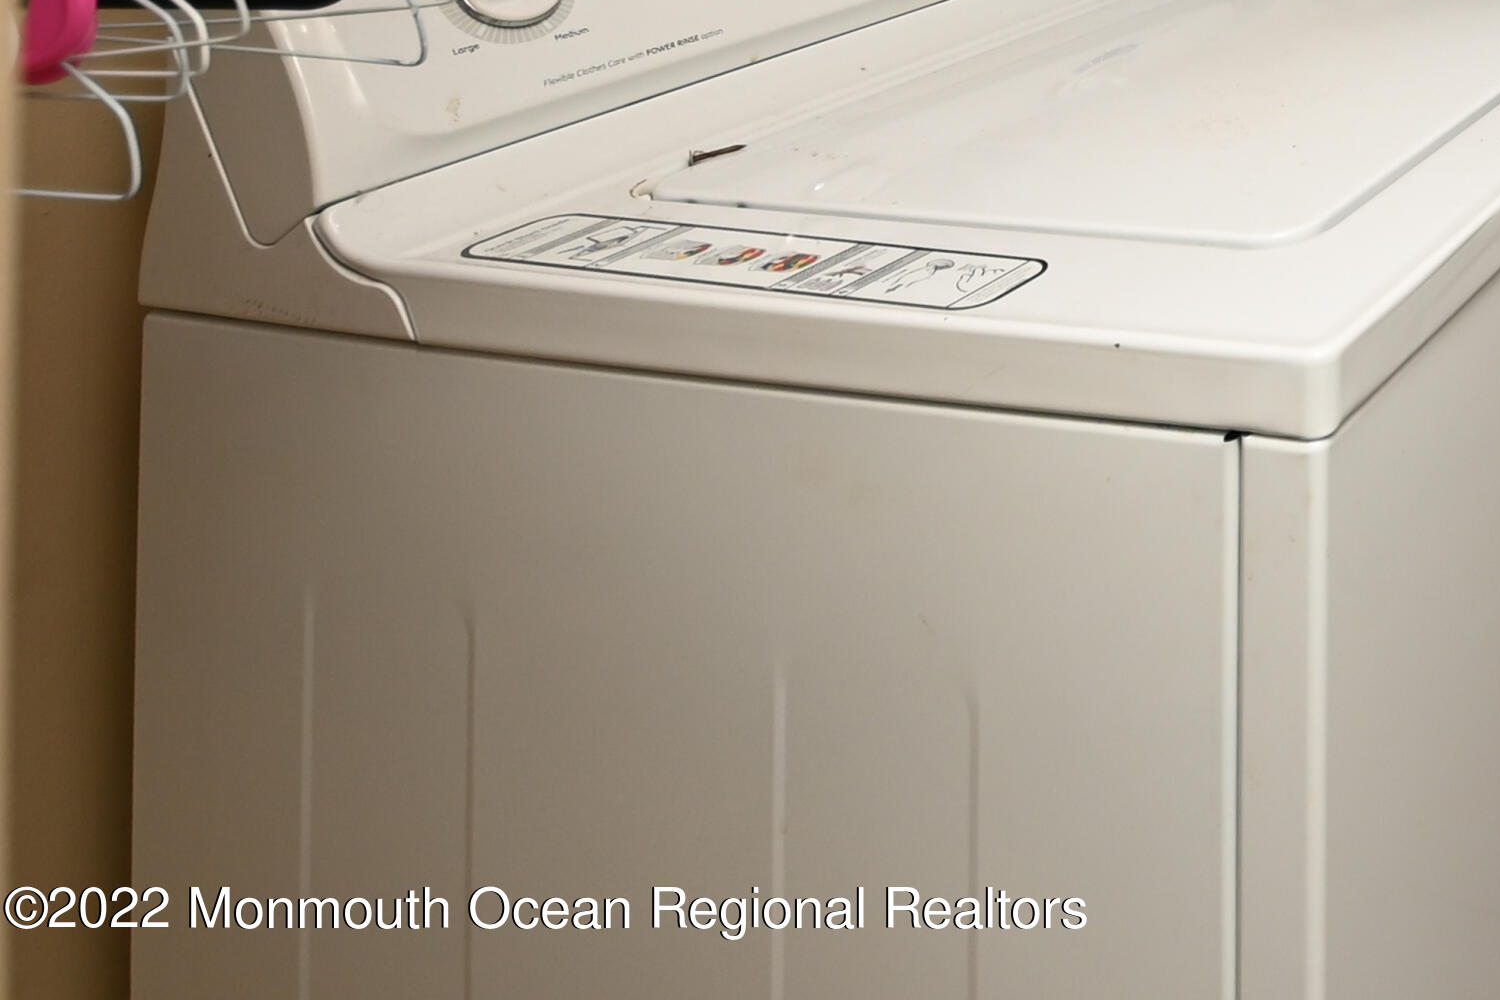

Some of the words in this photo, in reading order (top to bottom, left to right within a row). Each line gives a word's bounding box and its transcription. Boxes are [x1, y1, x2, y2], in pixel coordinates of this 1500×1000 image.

[452, 43, 480, 57] Large
[646, 42, 676, 56] POWER
[677, 34, 700, 46] RINSE
